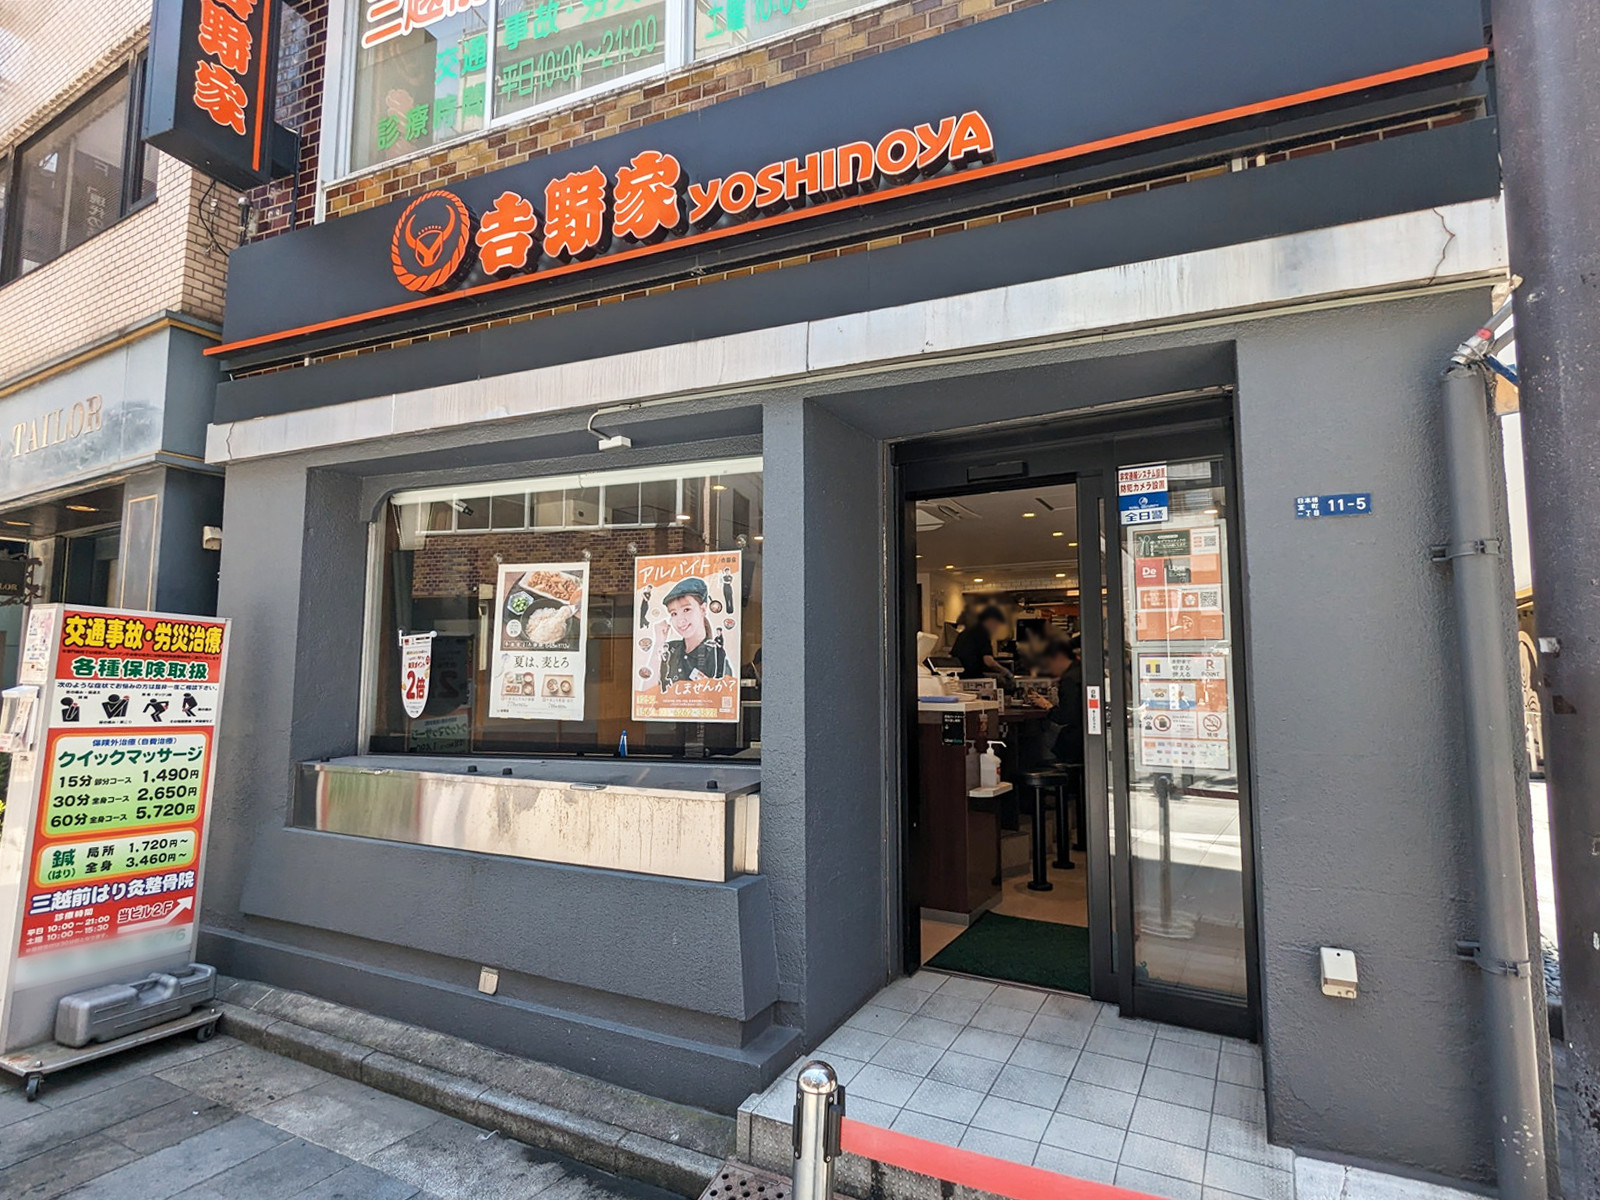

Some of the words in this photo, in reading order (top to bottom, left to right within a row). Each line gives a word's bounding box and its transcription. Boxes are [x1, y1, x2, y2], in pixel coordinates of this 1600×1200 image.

[476, 150, 681, 276] 吉野家
[688, 110, 994, 224] YOSHINOYA
[12, 394, 103, 459] TAILOR
[1328, 497, 1367, 512] 11-5
[641, 560, 711, 584] アルバイト
[64, 614, 223, 654] 交通事故・労災治療
[72, 658, 208, 679] 各種保険取扱
[514, 655, 570, 669] 夏は、麦とろ
[1206, 659, 1215, 669] R
[406, 671, 426, 699] 2倍
[675, 680, 737, 695] しませんか?
[58, 746, 203, 768] クイックマッサージ
[59, 775, 93, 788] 15分
[53, 794, 90, 808] 30分
[50, 813, 88, 828] 60分
[86, 845, 115, 858] 局所
[85, 860, 113, 874] 全身
[29, 869, 196, 915] 三越前はり灸整骨院
[117, 899, 174, 924] 当ビル2F
